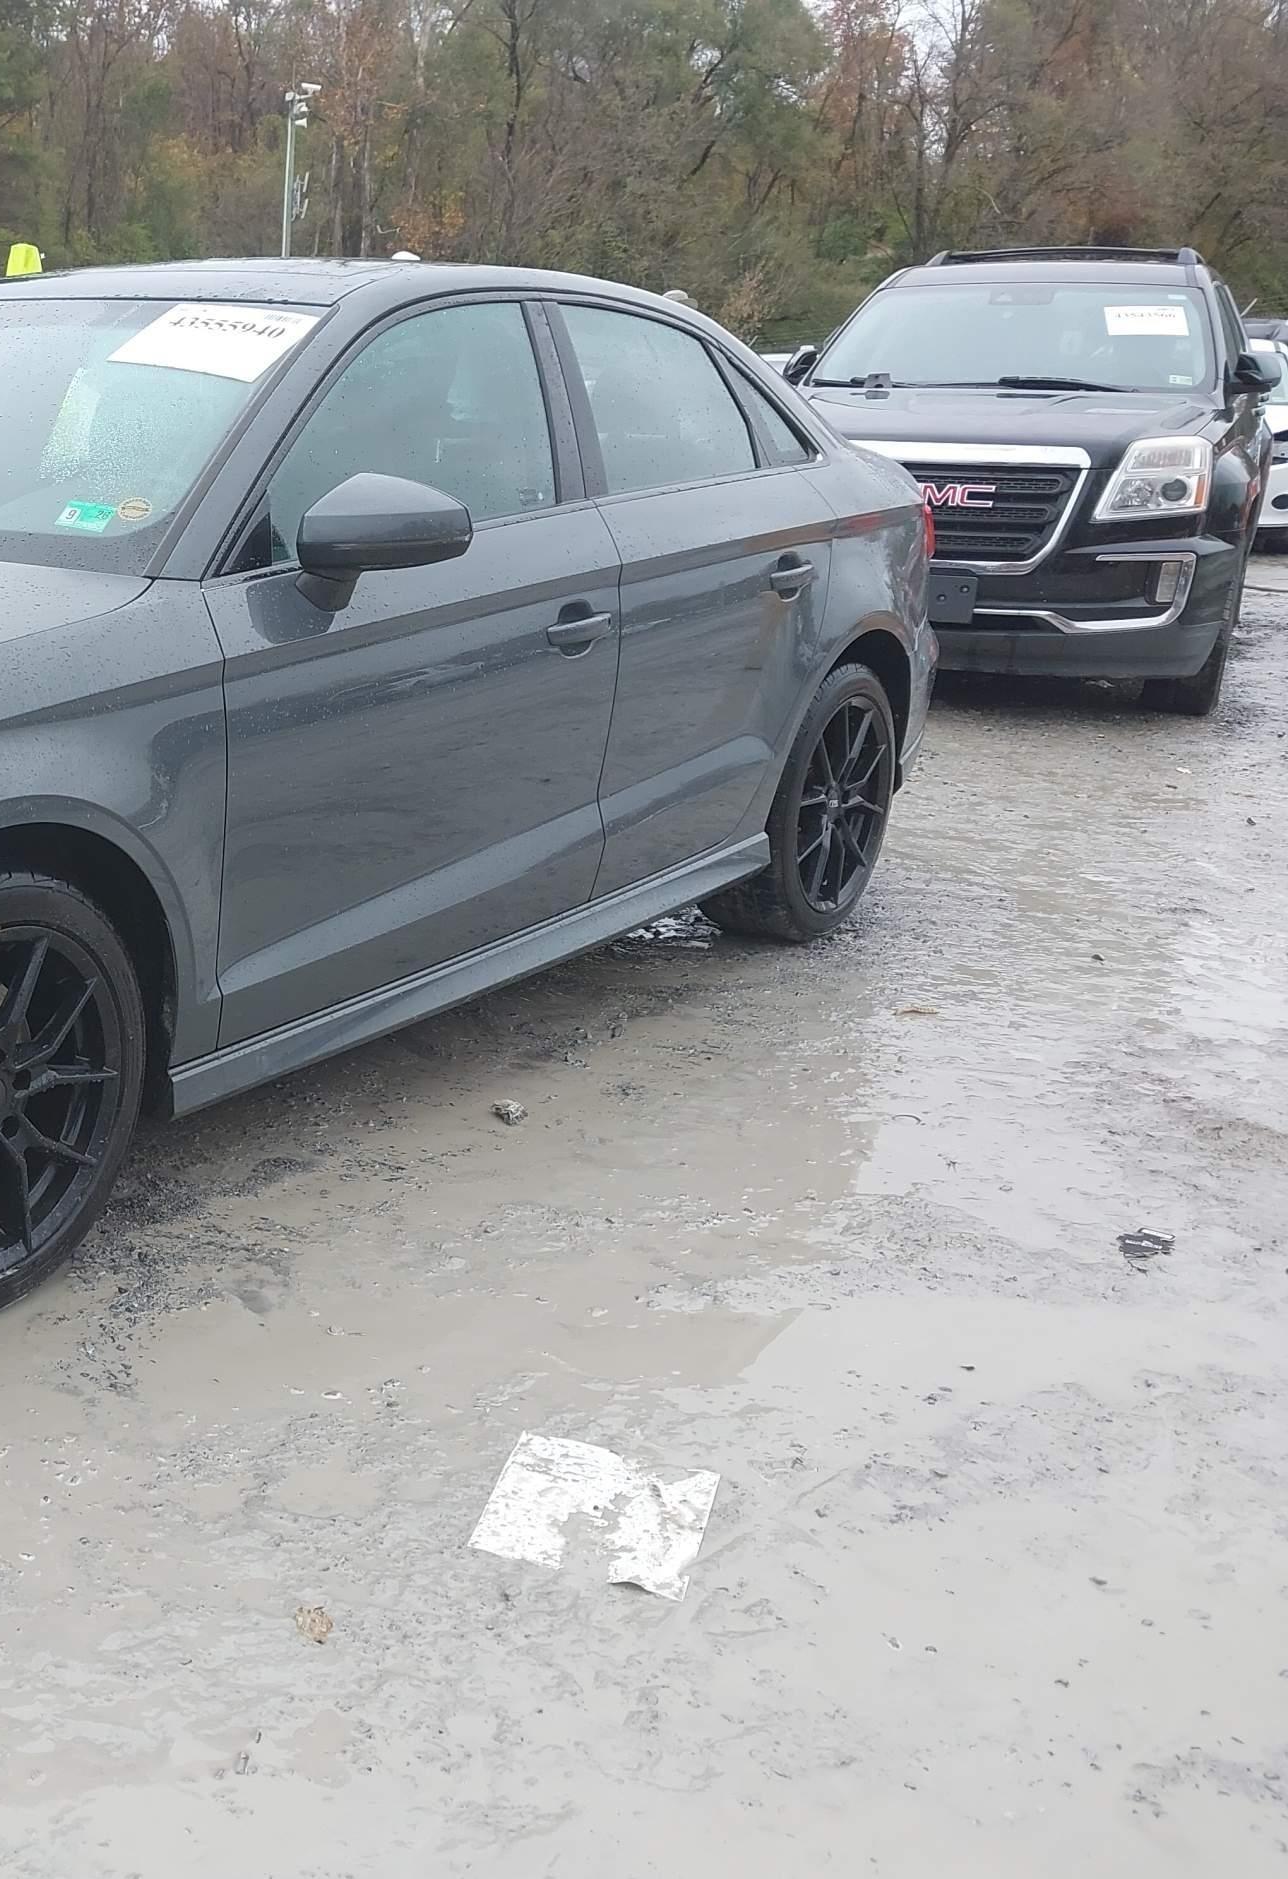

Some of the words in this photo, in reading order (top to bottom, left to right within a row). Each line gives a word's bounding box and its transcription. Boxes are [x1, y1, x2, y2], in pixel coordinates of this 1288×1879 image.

[168, 316, 286, 338] 43555940
[918, 483, 996, 508] MC
[65, 510, 77, 519] 9
